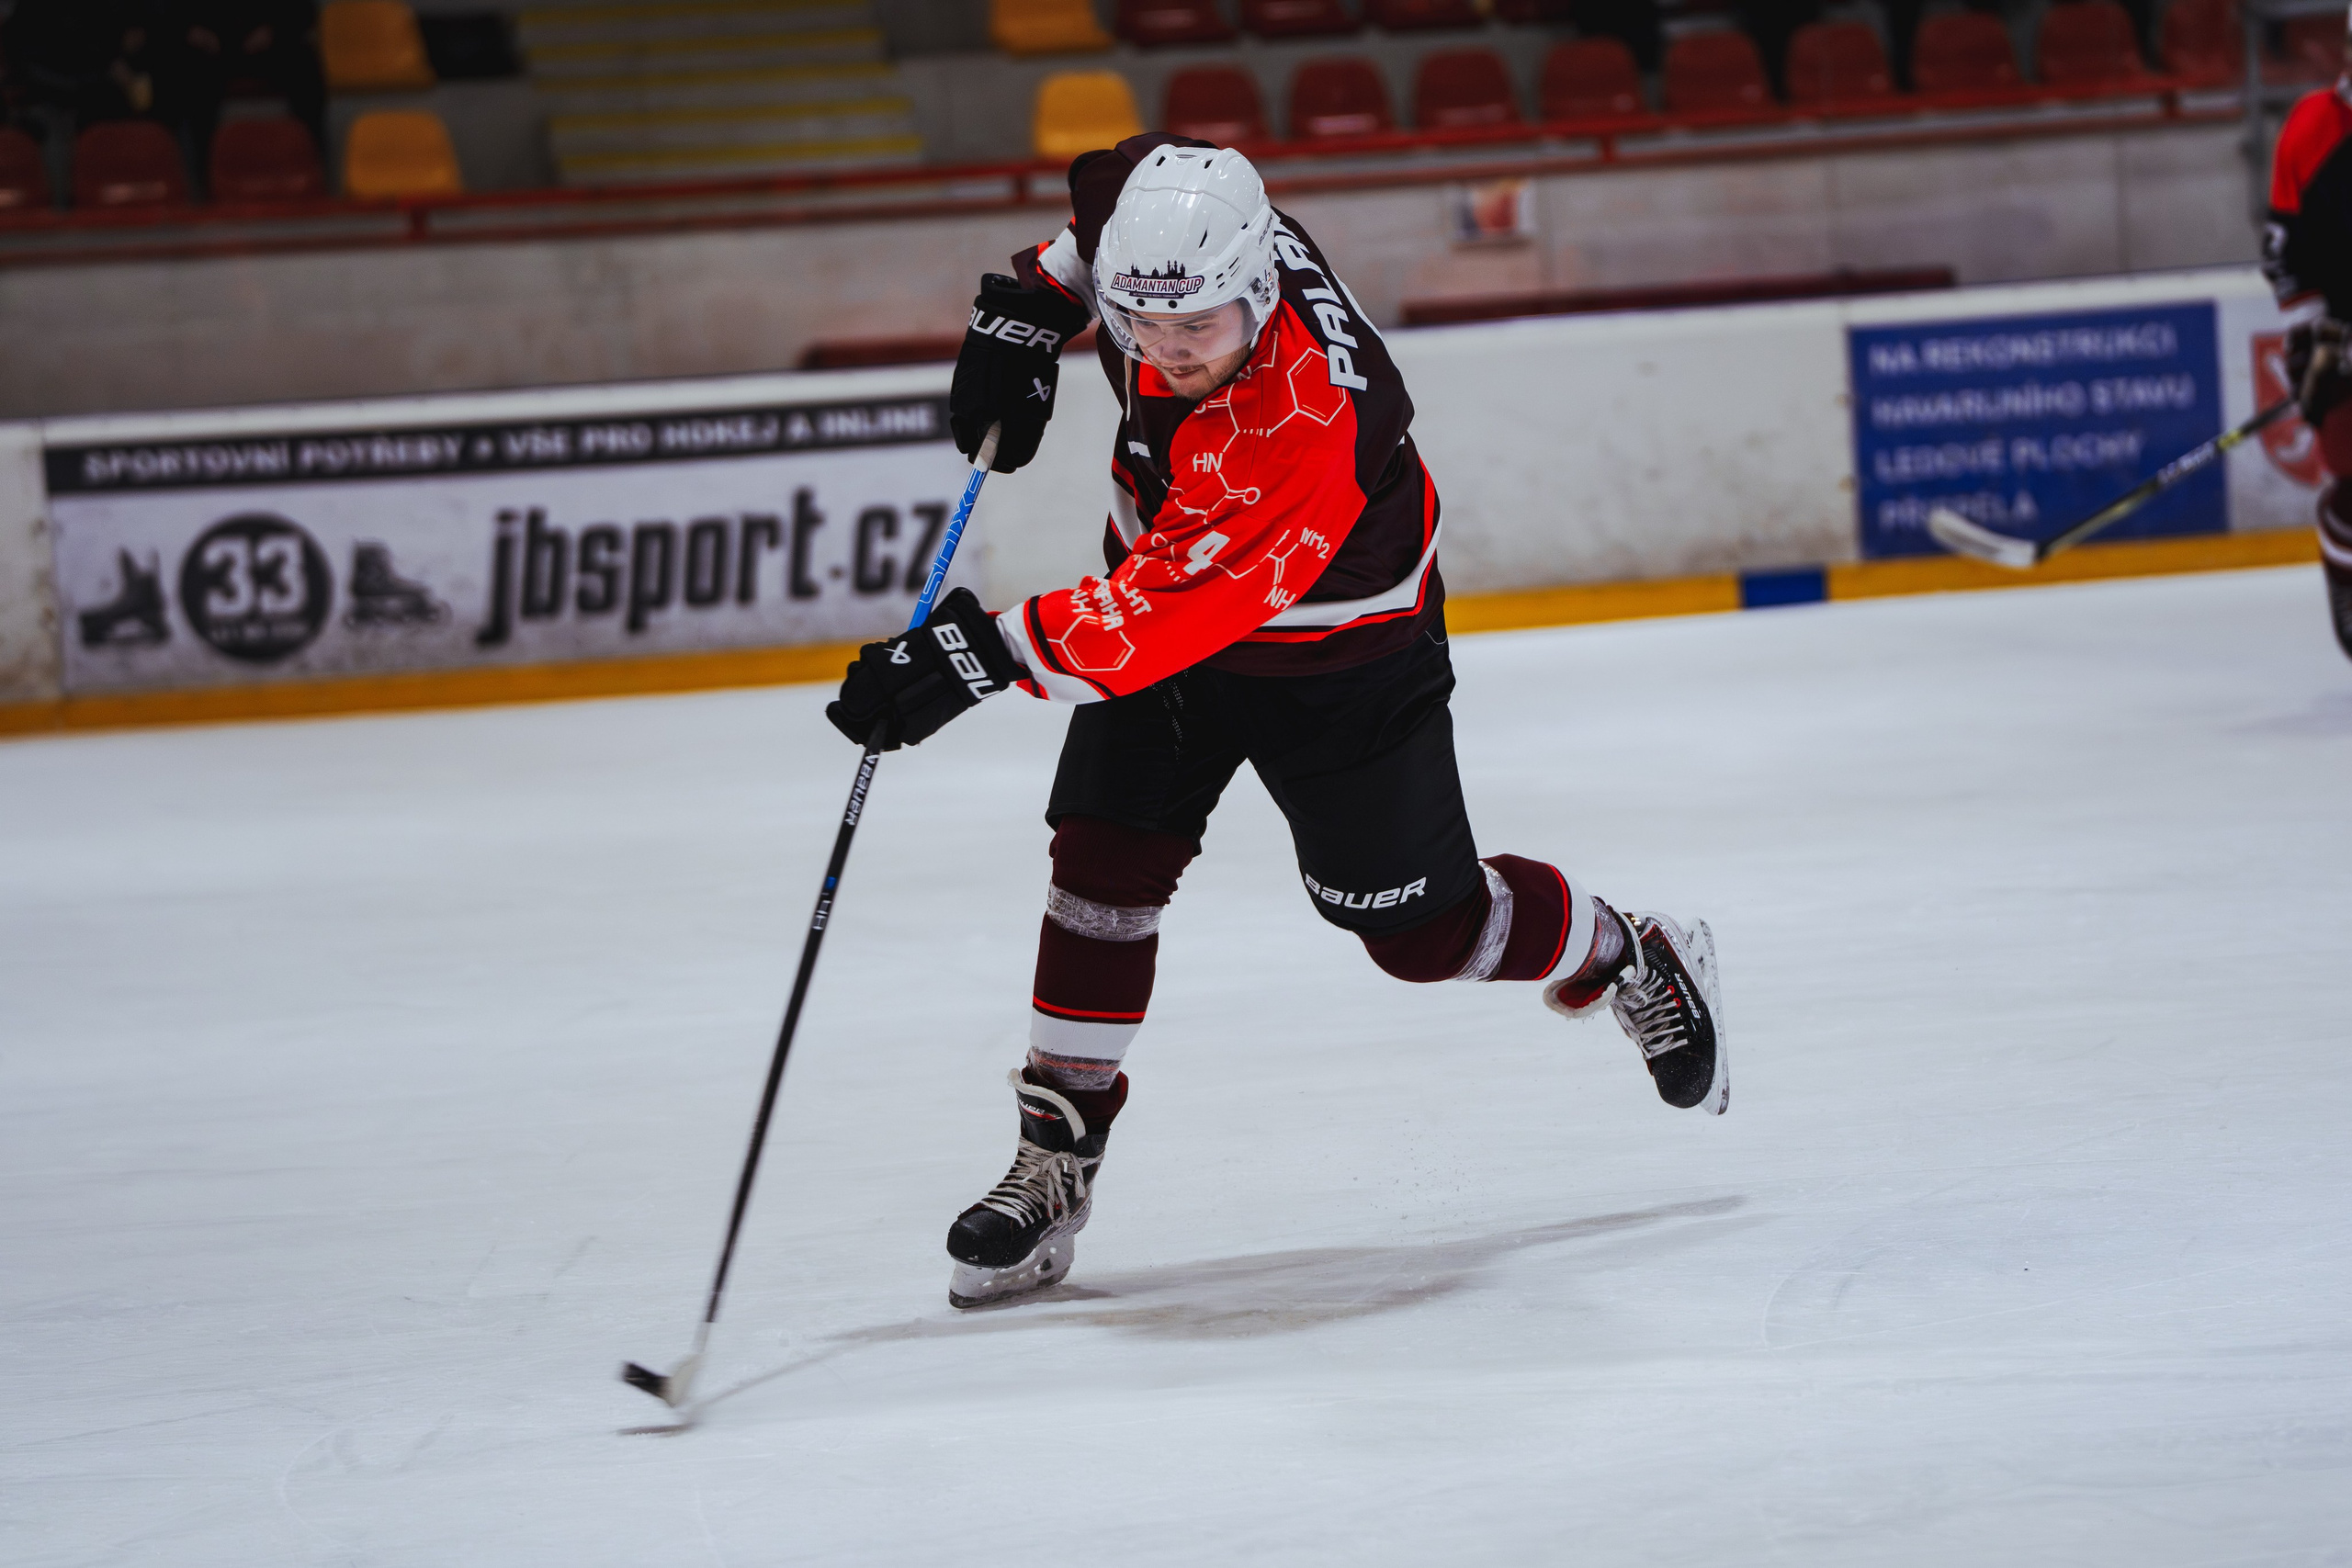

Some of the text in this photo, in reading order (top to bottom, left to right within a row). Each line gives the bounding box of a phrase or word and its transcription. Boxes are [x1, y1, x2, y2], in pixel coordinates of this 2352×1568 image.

[1113, 275, 1203, 294] ADAMANTAN CUP
[84, 441, 289, 482] SPORTOVNÍ
[505, 424, 575, 457] VŠE
[581, 423, 651, 456] PRO
[664, 415, 778, 449] HOKEJ
[786, 412, 815, 442] A
[826, 403, 937, 436] INLINE
[1193, 452, 1223, 473] HN
[203, 533, 306, 618] 33
[476, 485, 950, 646] jbsport.cz
[1182, 530, 1231, 576] 4
[1263, 585, 1296, 611] NH
